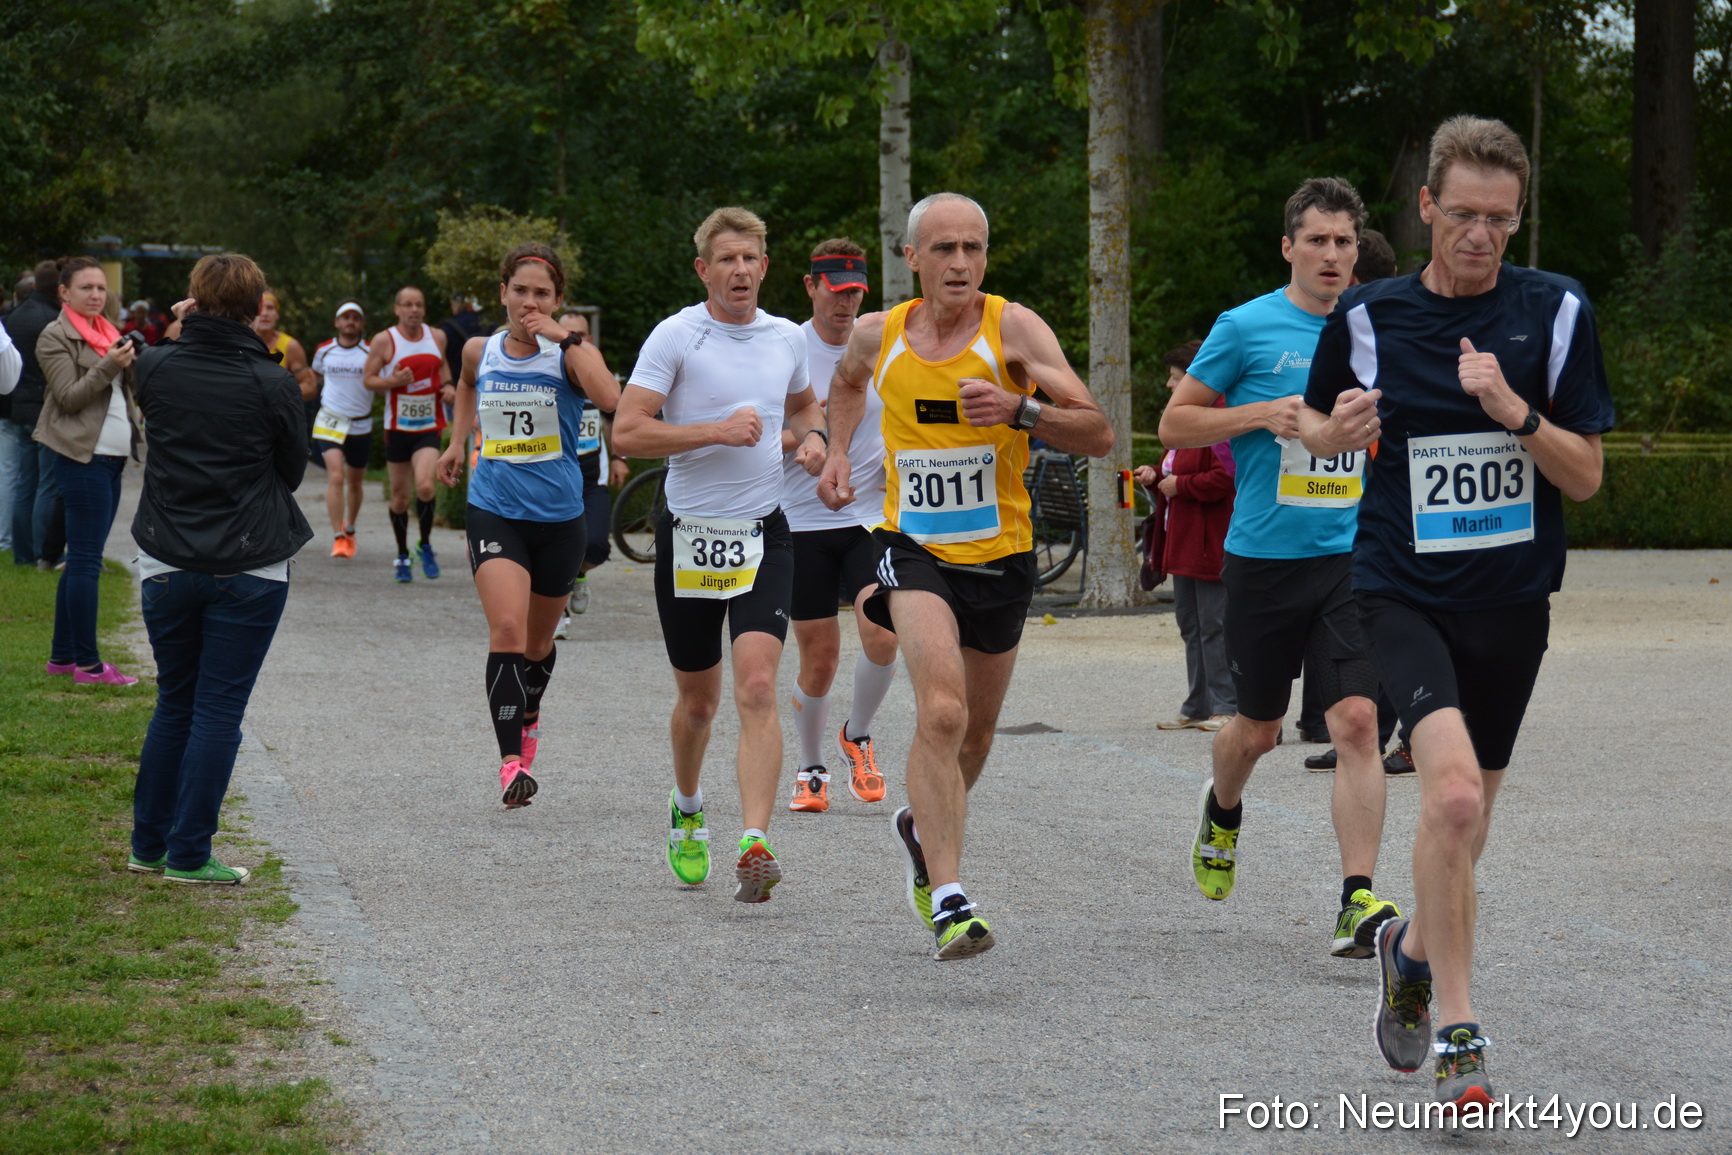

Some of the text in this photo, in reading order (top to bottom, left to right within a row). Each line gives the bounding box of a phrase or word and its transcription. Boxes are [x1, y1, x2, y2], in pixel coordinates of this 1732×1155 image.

[495, 382, 557, 395] TELIS FINANZ
[401, 403, 433, 418] 2695
[502, 410, 535, 436] 73
[495, 441, 547, 454] Eva-Maria
[1412, 443, 1516, 459] PARTL Neumarkt
[897, 456, 979, 468] PARTL Neumarkt
[908, 469, 984, 508] 3011
[1306, 481, 1348, 495] Steffen
[1425, 458, 1524, 506] 2603
[675, 524, 748, 536] PARTL Neumarkt
[1452, 514, 1503, 533] Martin
[691, 537, 746, 569] 383
[700, 575, 738, 591] Jürgen
